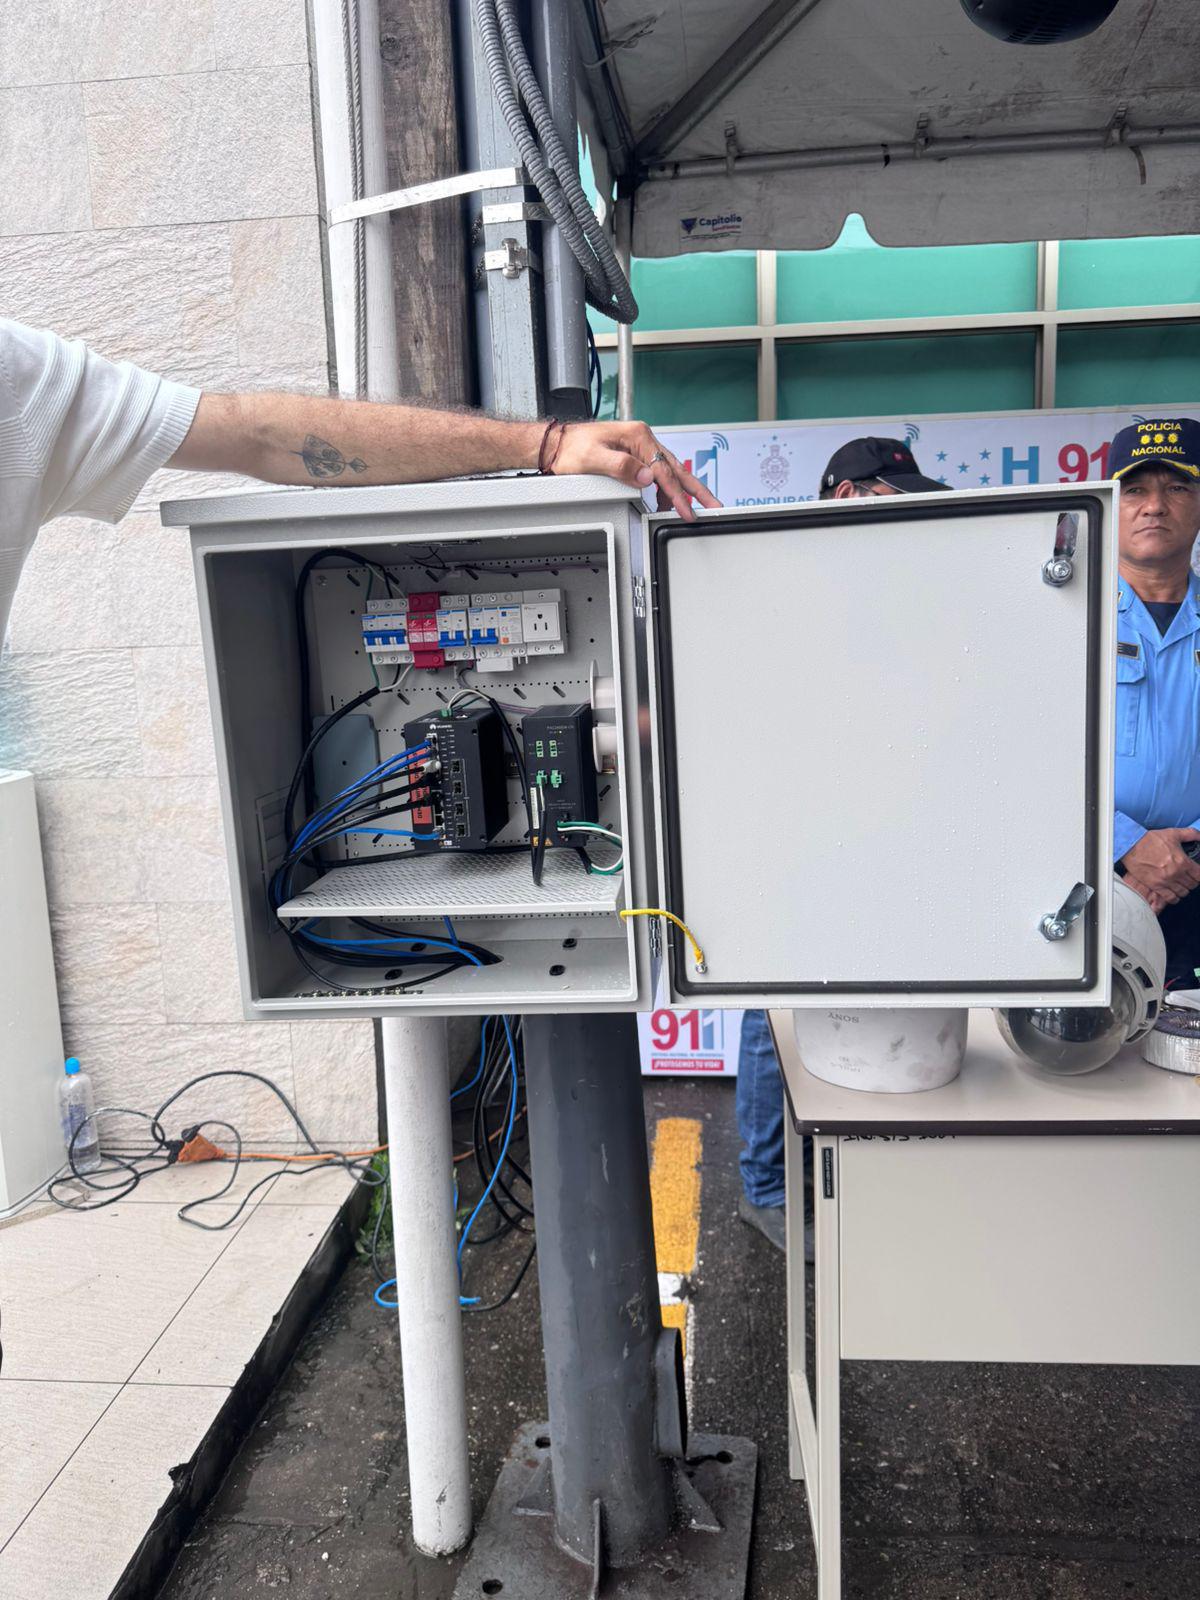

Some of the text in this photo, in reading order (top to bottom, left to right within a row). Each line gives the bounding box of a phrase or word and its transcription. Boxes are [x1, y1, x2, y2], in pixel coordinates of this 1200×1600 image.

[699, 213, 742, 226] Capitolio
[1137, 422, 1182, 433] POLICIA
[1131, 446, 1186, 457] NACIONAL
[1002, 446, 1039, 485] H
[1058, 442, 1112, 483] 91
[826, 1012, 860, 1024] SONY
[651, 1009, 724, 1051] 911
